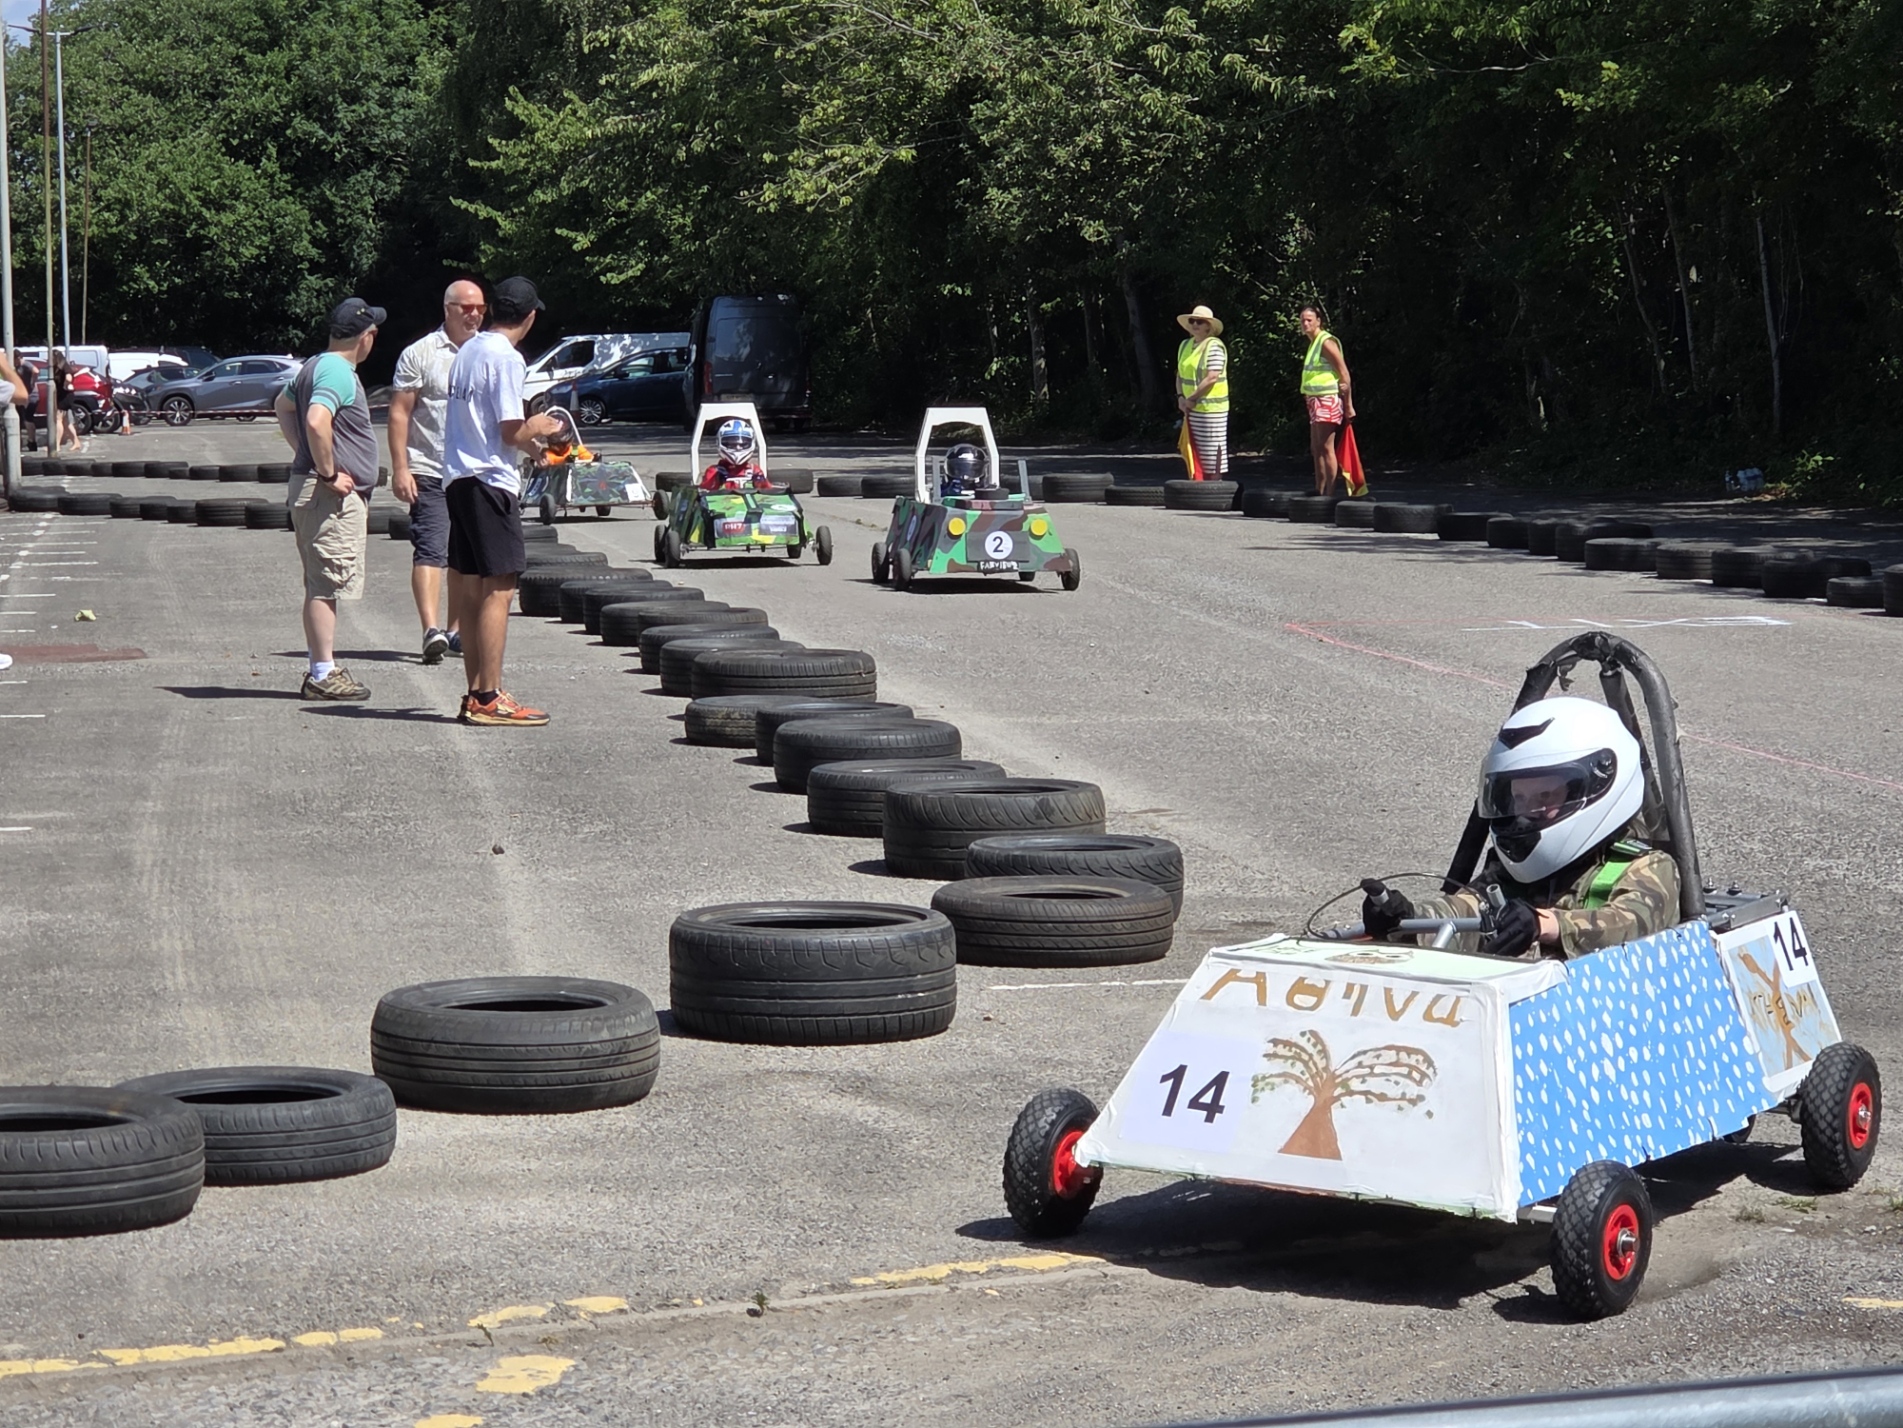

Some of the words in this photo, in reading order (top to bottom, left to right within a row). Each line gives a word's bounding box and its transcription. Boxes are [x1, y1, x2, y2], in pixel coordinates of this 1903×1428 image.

[992, 535, 1004, 553] 2
[1773, 916, 1809, 972] 14
[1159, 1063, 1230, 1124] 14
